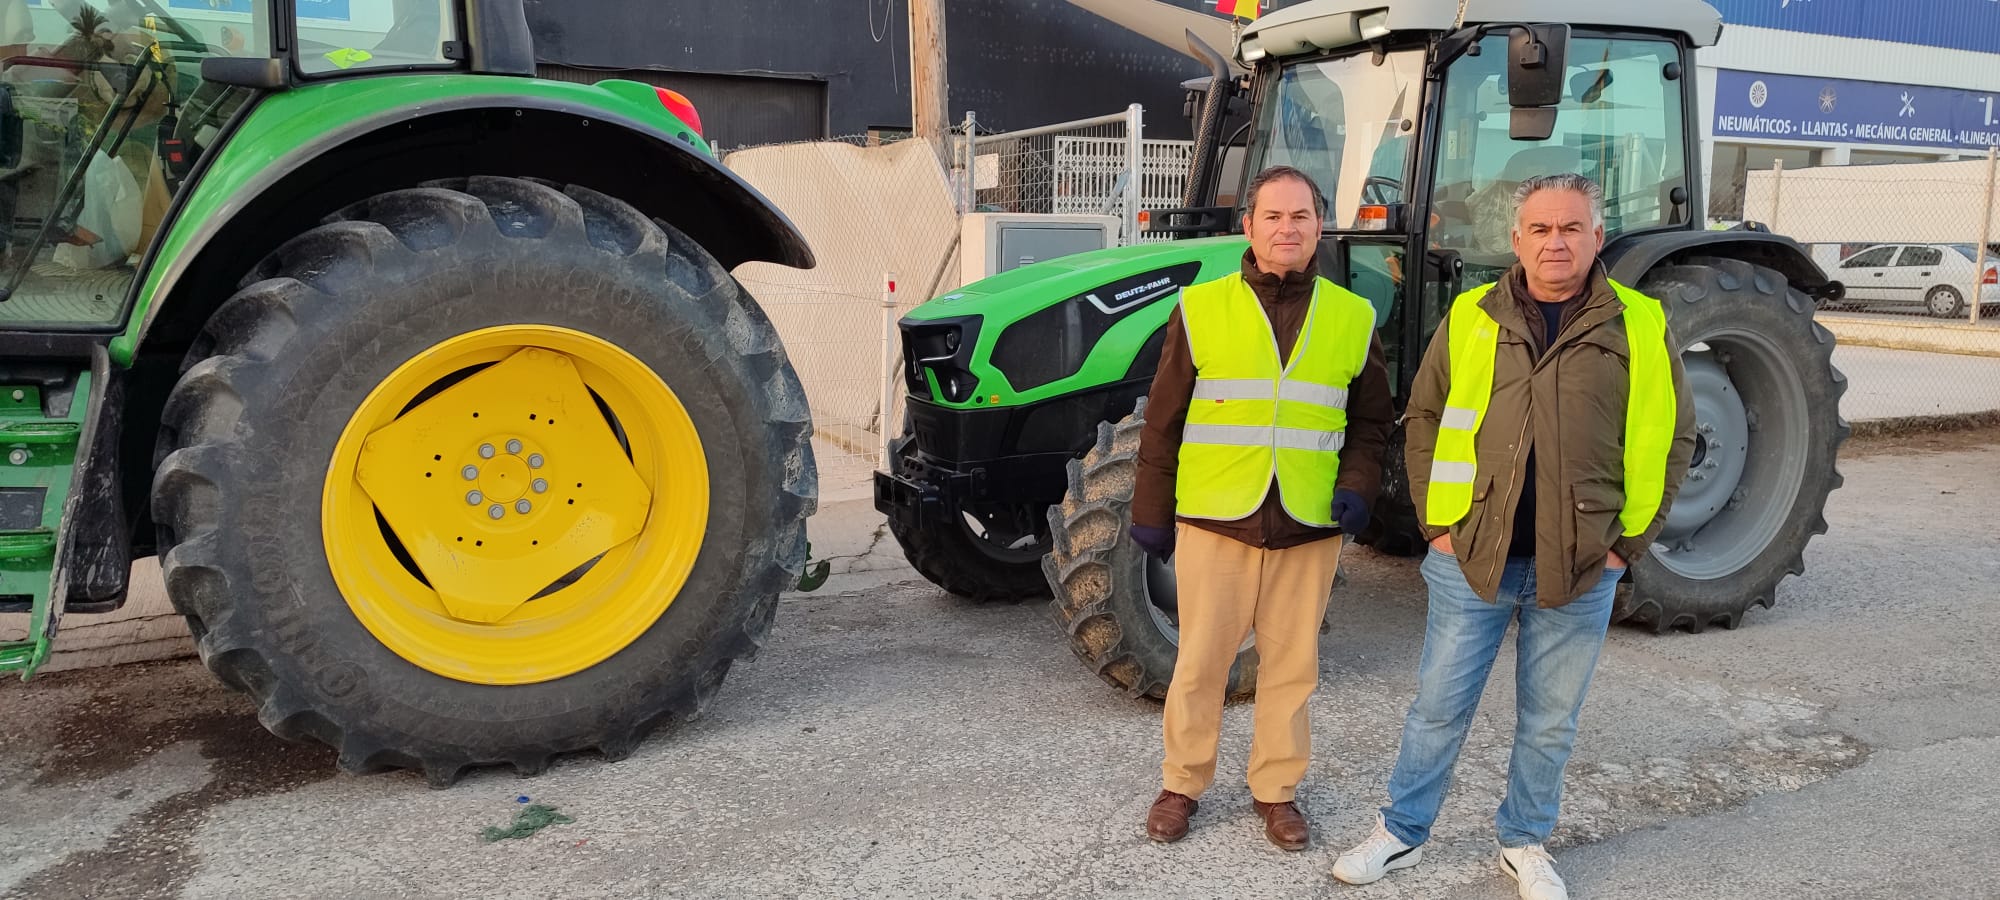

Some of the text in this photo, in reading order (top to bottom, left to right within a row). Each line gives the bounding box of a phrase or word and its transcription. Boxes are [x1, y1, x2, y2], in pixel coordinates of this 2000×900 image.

[1718, 115, 2000, 145] NEUMÁTICOS LLANTAS MECÁNICA GENERAL ALINEACI
[1114, 277, 1171, 301] DEUTZ-FAHR
